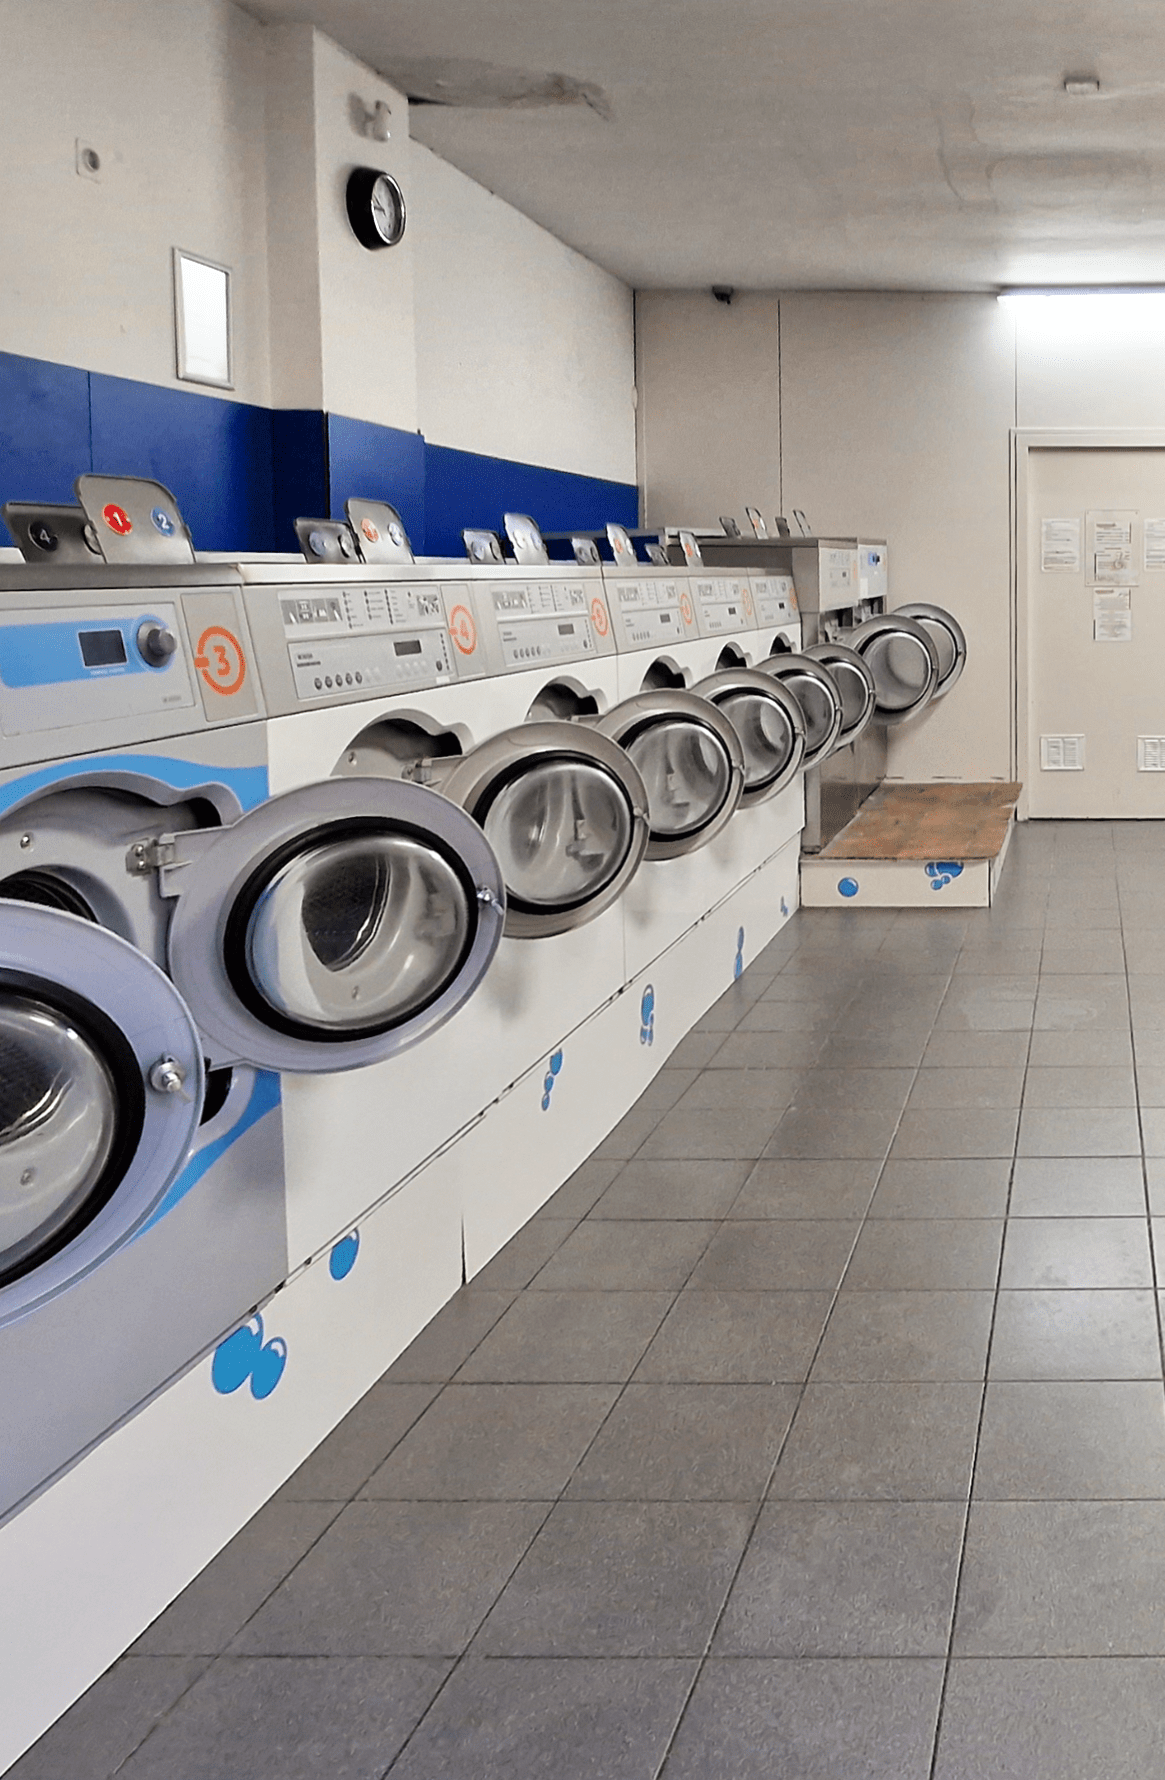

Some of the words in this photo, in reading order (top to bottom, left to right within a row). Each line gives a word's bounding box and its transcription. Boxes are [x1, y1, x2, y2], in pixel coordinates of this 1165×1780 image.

[112, 511, 124, 527] 1
[157, 513, 171, 530] 2
[39, 528, 51, 544] 4
[459, 618, 470, 641] 4
[212, 645, 231, 678] 3
